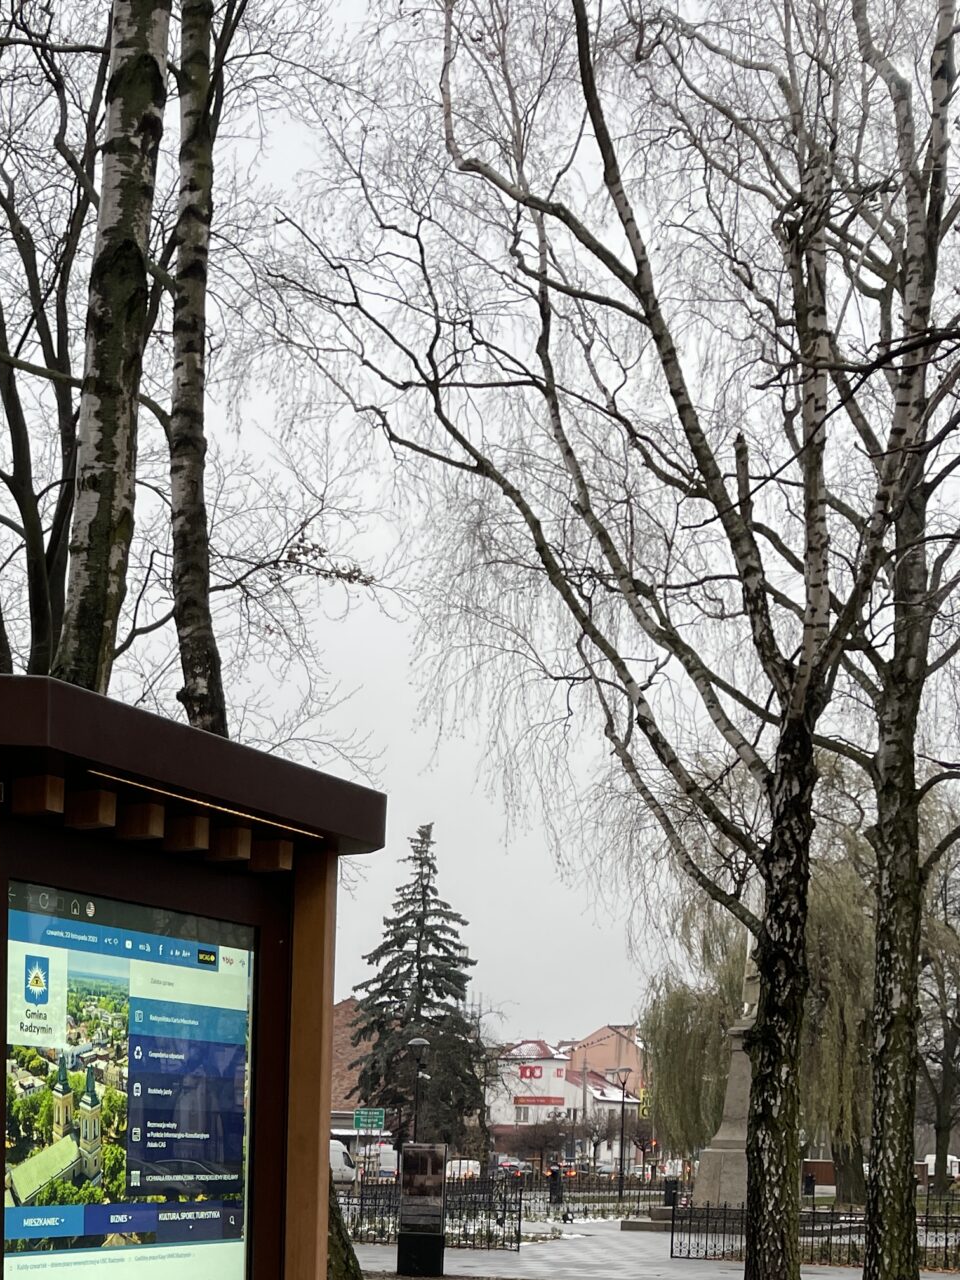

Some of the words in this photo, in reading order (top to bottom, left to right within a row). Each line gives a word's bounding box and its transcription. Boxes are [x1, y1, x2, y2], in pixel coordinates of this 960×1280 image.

[26, 1011, 47, 1021] Gmina
[20, 1023, 52, 1037] Radzymin
[110, 1214, 127, 1223] BIZNES
[196, 1210, 220, 1220] TURYSTYKA
[23, 1217, 59, 1228] MIESZKANIEC
